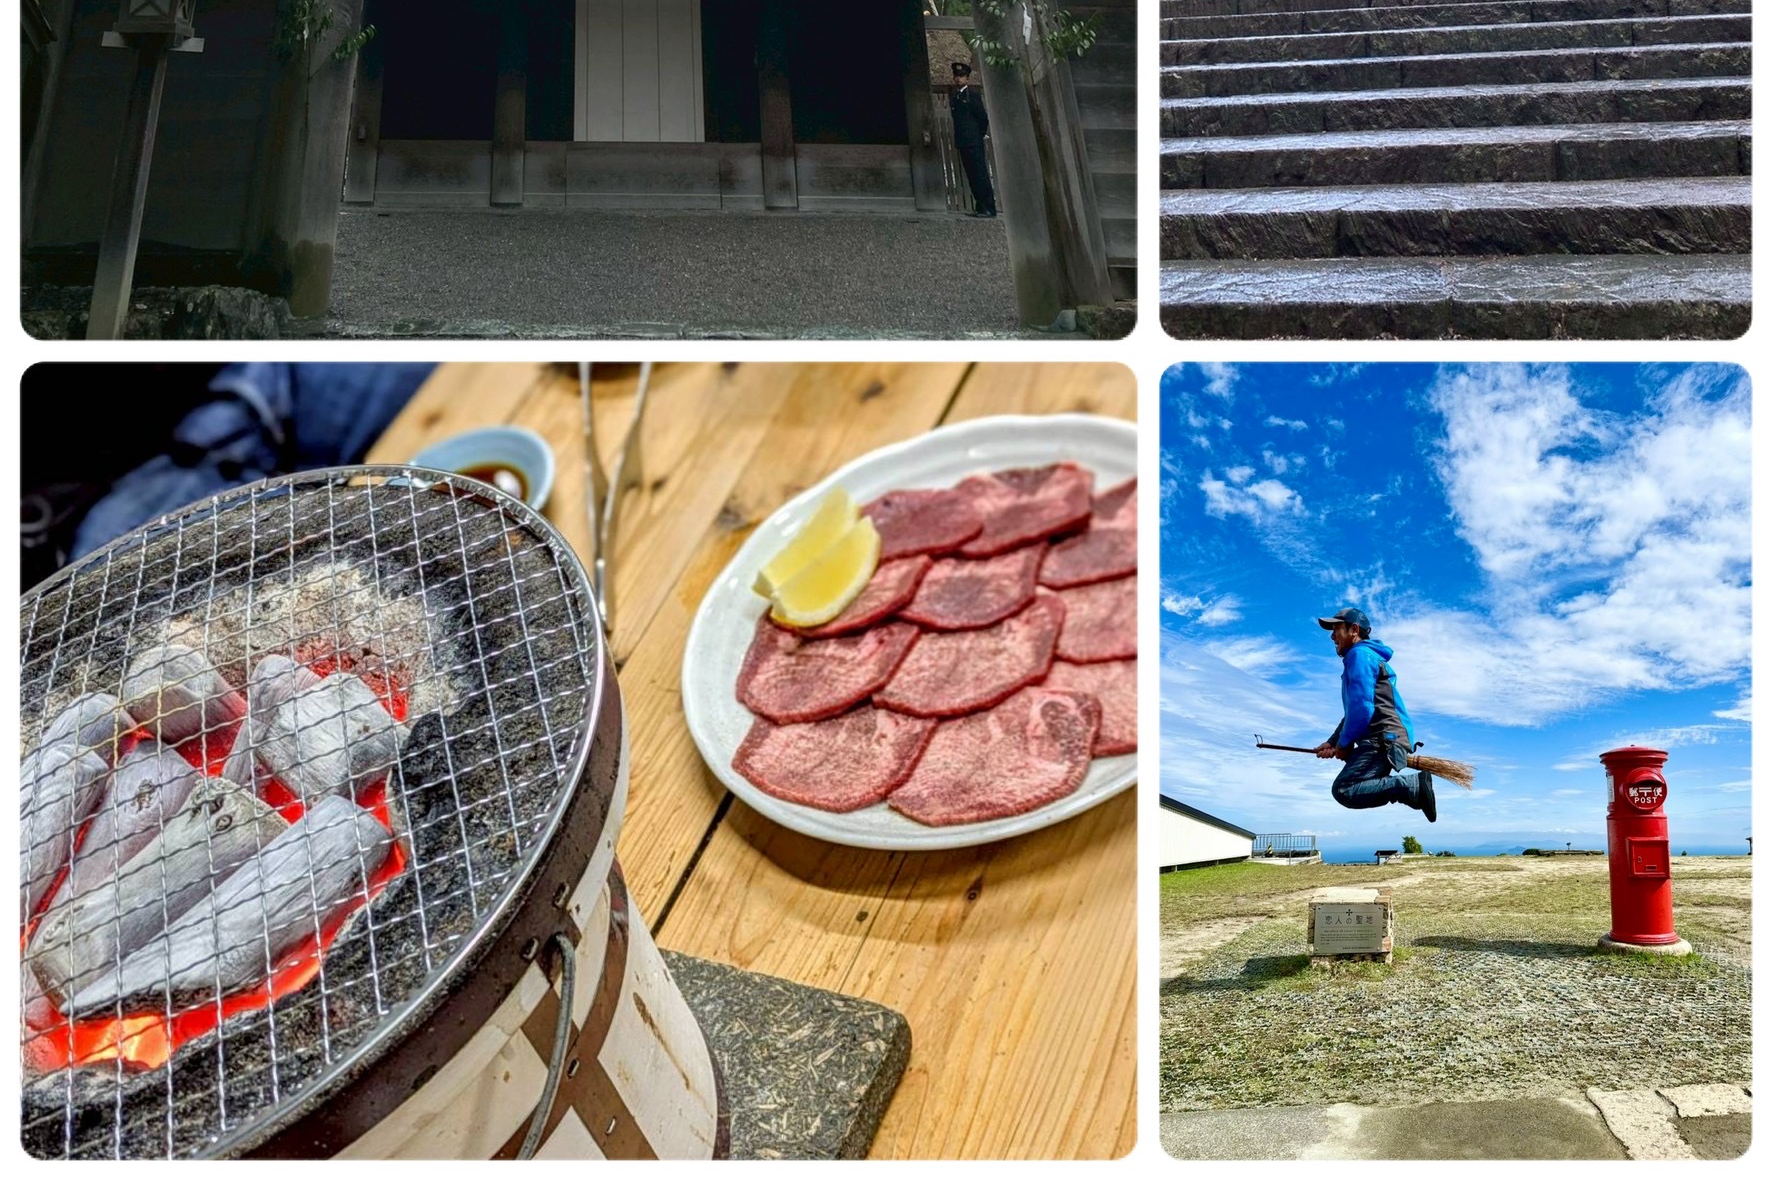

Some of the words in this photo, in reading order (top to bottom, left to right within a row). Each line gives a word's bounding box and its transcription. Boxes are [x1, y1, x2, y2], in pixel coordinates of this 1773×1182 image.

[1325, 915, 1373, 925] 恋人の聖地
